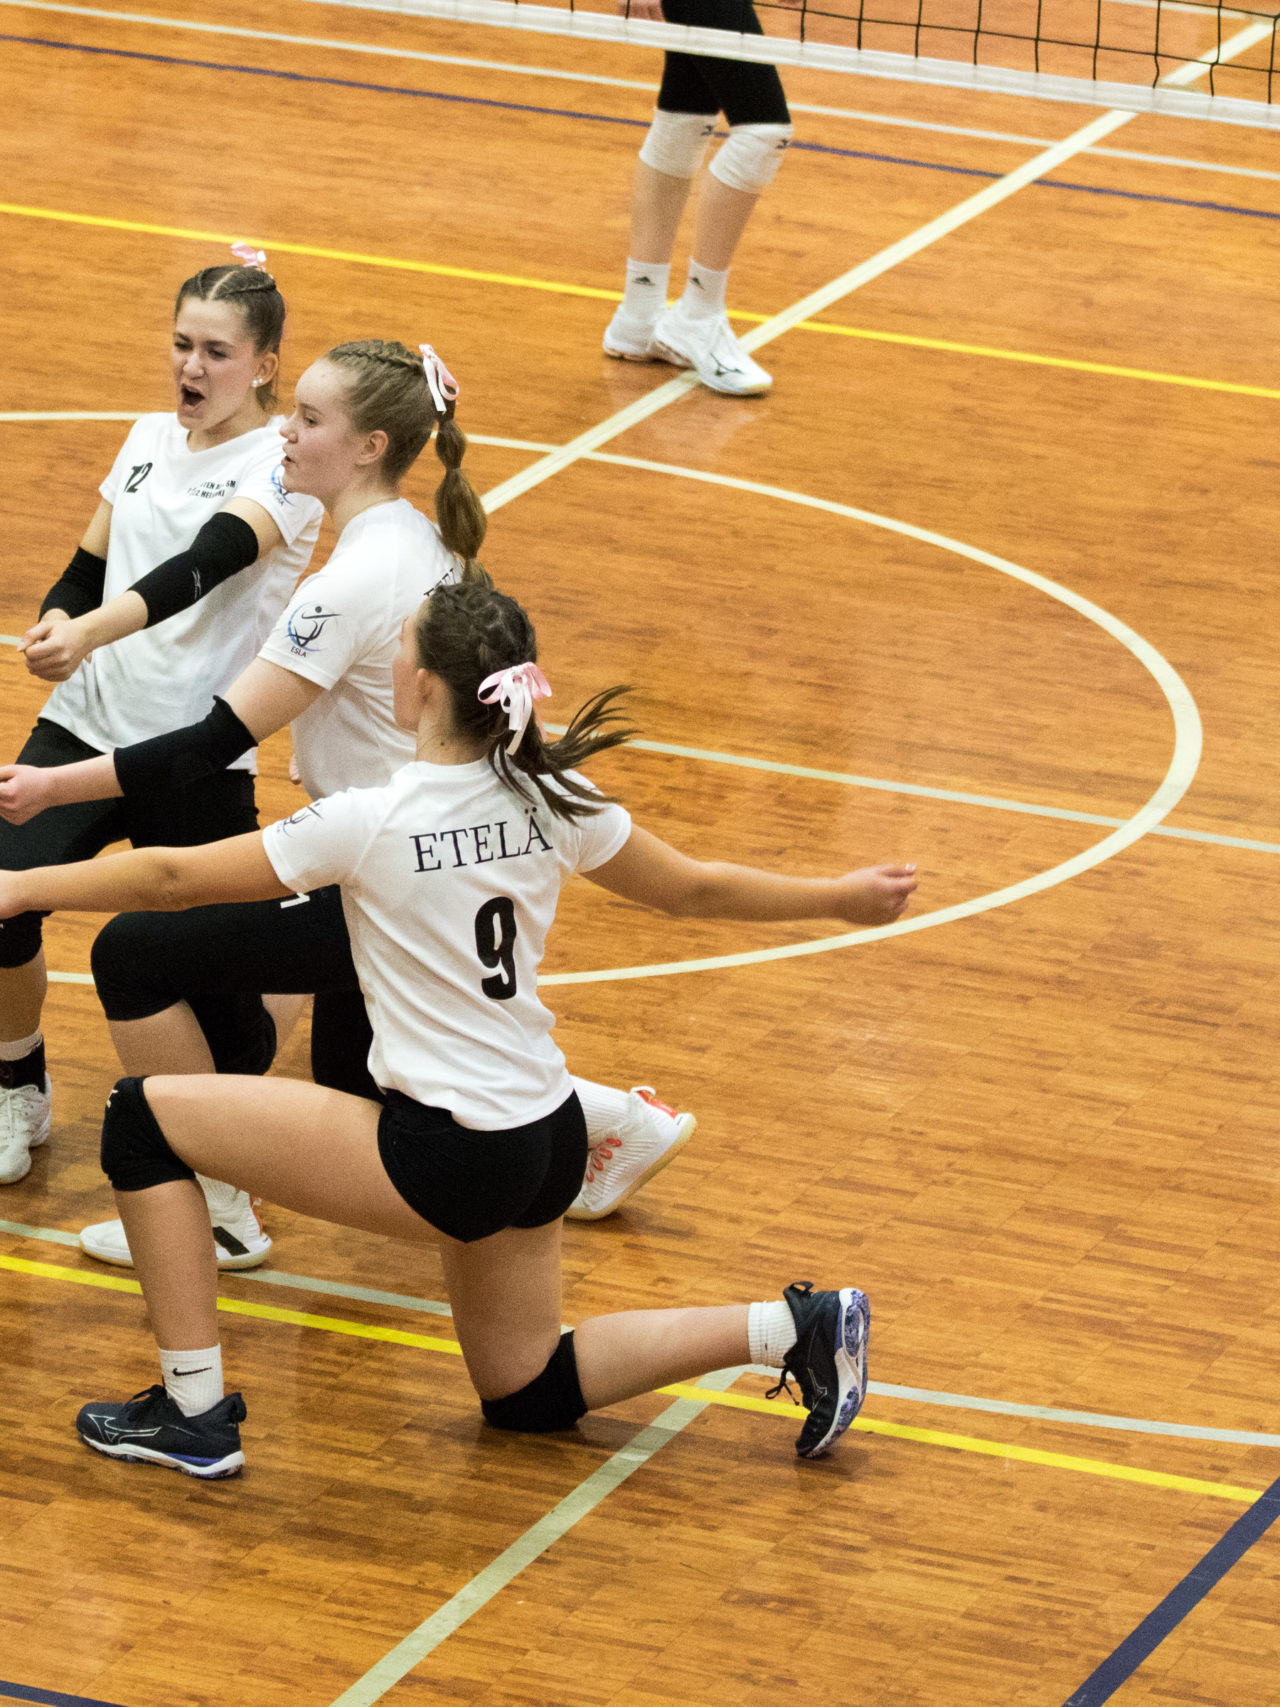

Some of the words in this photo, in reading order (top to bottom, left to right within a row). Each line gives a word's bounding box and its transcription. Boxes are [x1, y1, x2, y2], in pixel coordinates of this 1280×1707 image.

[123, 462, 153, 493] 12
[409, 806, 553, 872] ETELÄ
[475, 896, 517, 1000] 9
